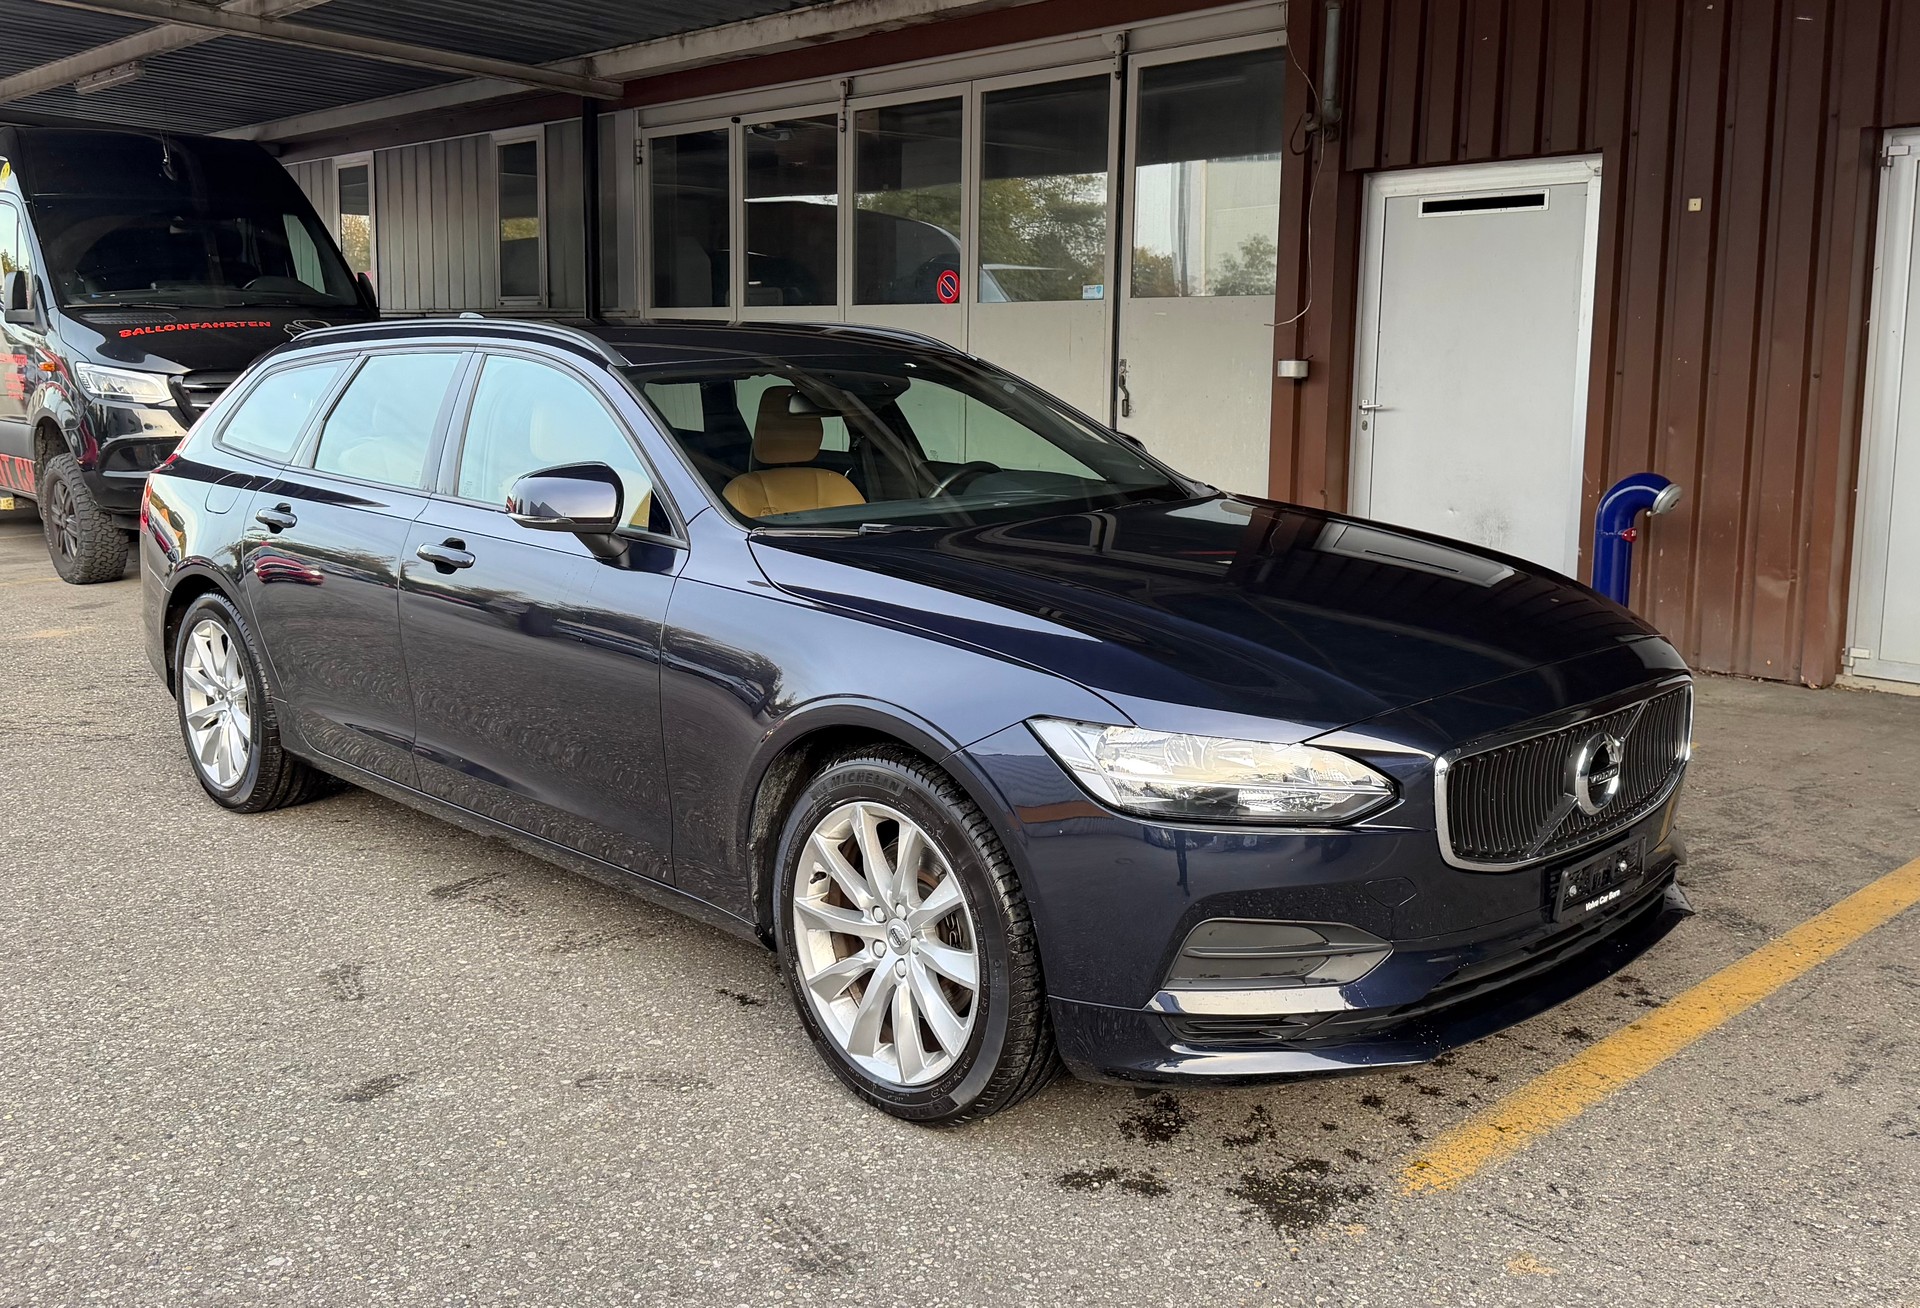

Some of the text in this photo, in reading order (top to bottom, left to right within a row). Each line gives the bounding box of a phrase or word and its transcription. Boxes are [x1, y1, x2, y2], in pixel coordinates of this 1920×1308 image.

[119, 321, 271, 338] BALLONFAHRTEN
[831, 770, 901, 793] MICHELIN
[1589, 768, 1617, 783] VOLVO
[1585, 899, 1599, 911] Volvo
[1600, 895, 1609, 904] Car
